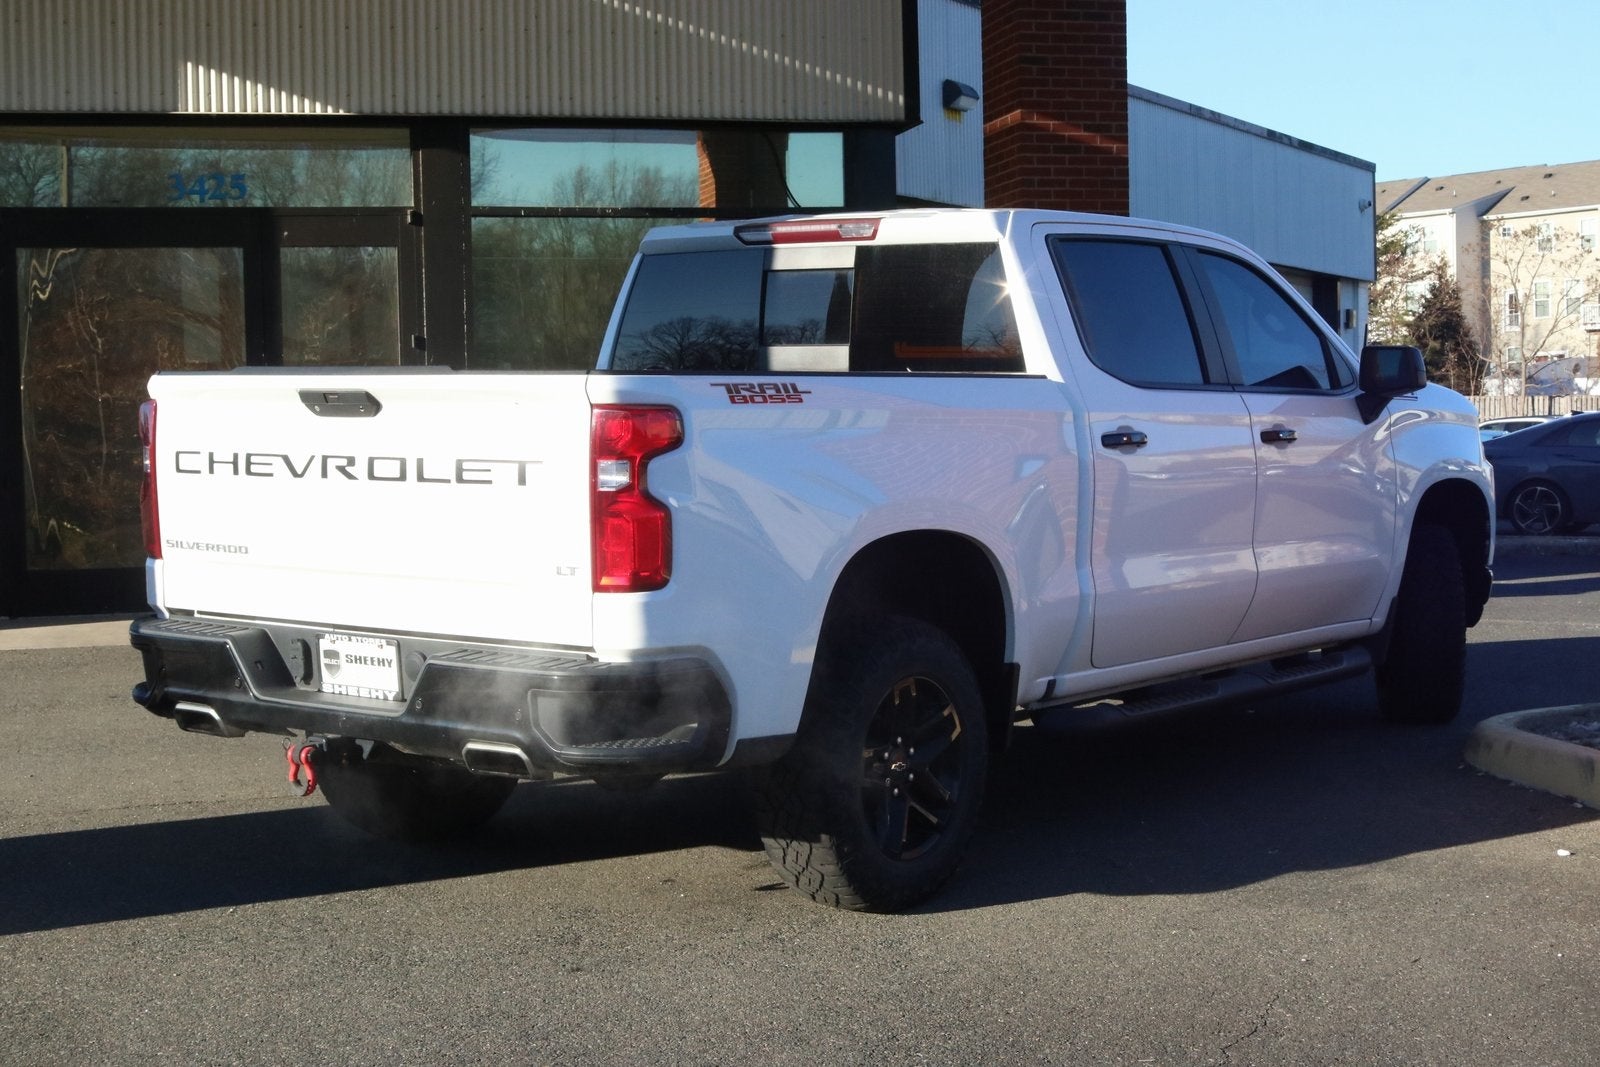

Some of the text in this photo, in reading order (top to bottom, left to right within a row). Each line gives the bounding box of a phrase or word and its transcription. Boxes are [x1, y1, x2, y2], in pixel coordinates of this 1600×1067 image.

[167, 173, 248, 203] 3425
[709, 383, 812, 394] TRAIL
[728, 394, 804, 405] BOSS
[175, 450, 544, 487] CHEVROLET
[166, 539, 249, 555] SILVERADO
[556, 566, 579, 577] LT
[324, 633, 349, 643] AUTO
[345, 653, 394, 669] SHEEHY
[321, 682, 398, 702] SHEEHY
